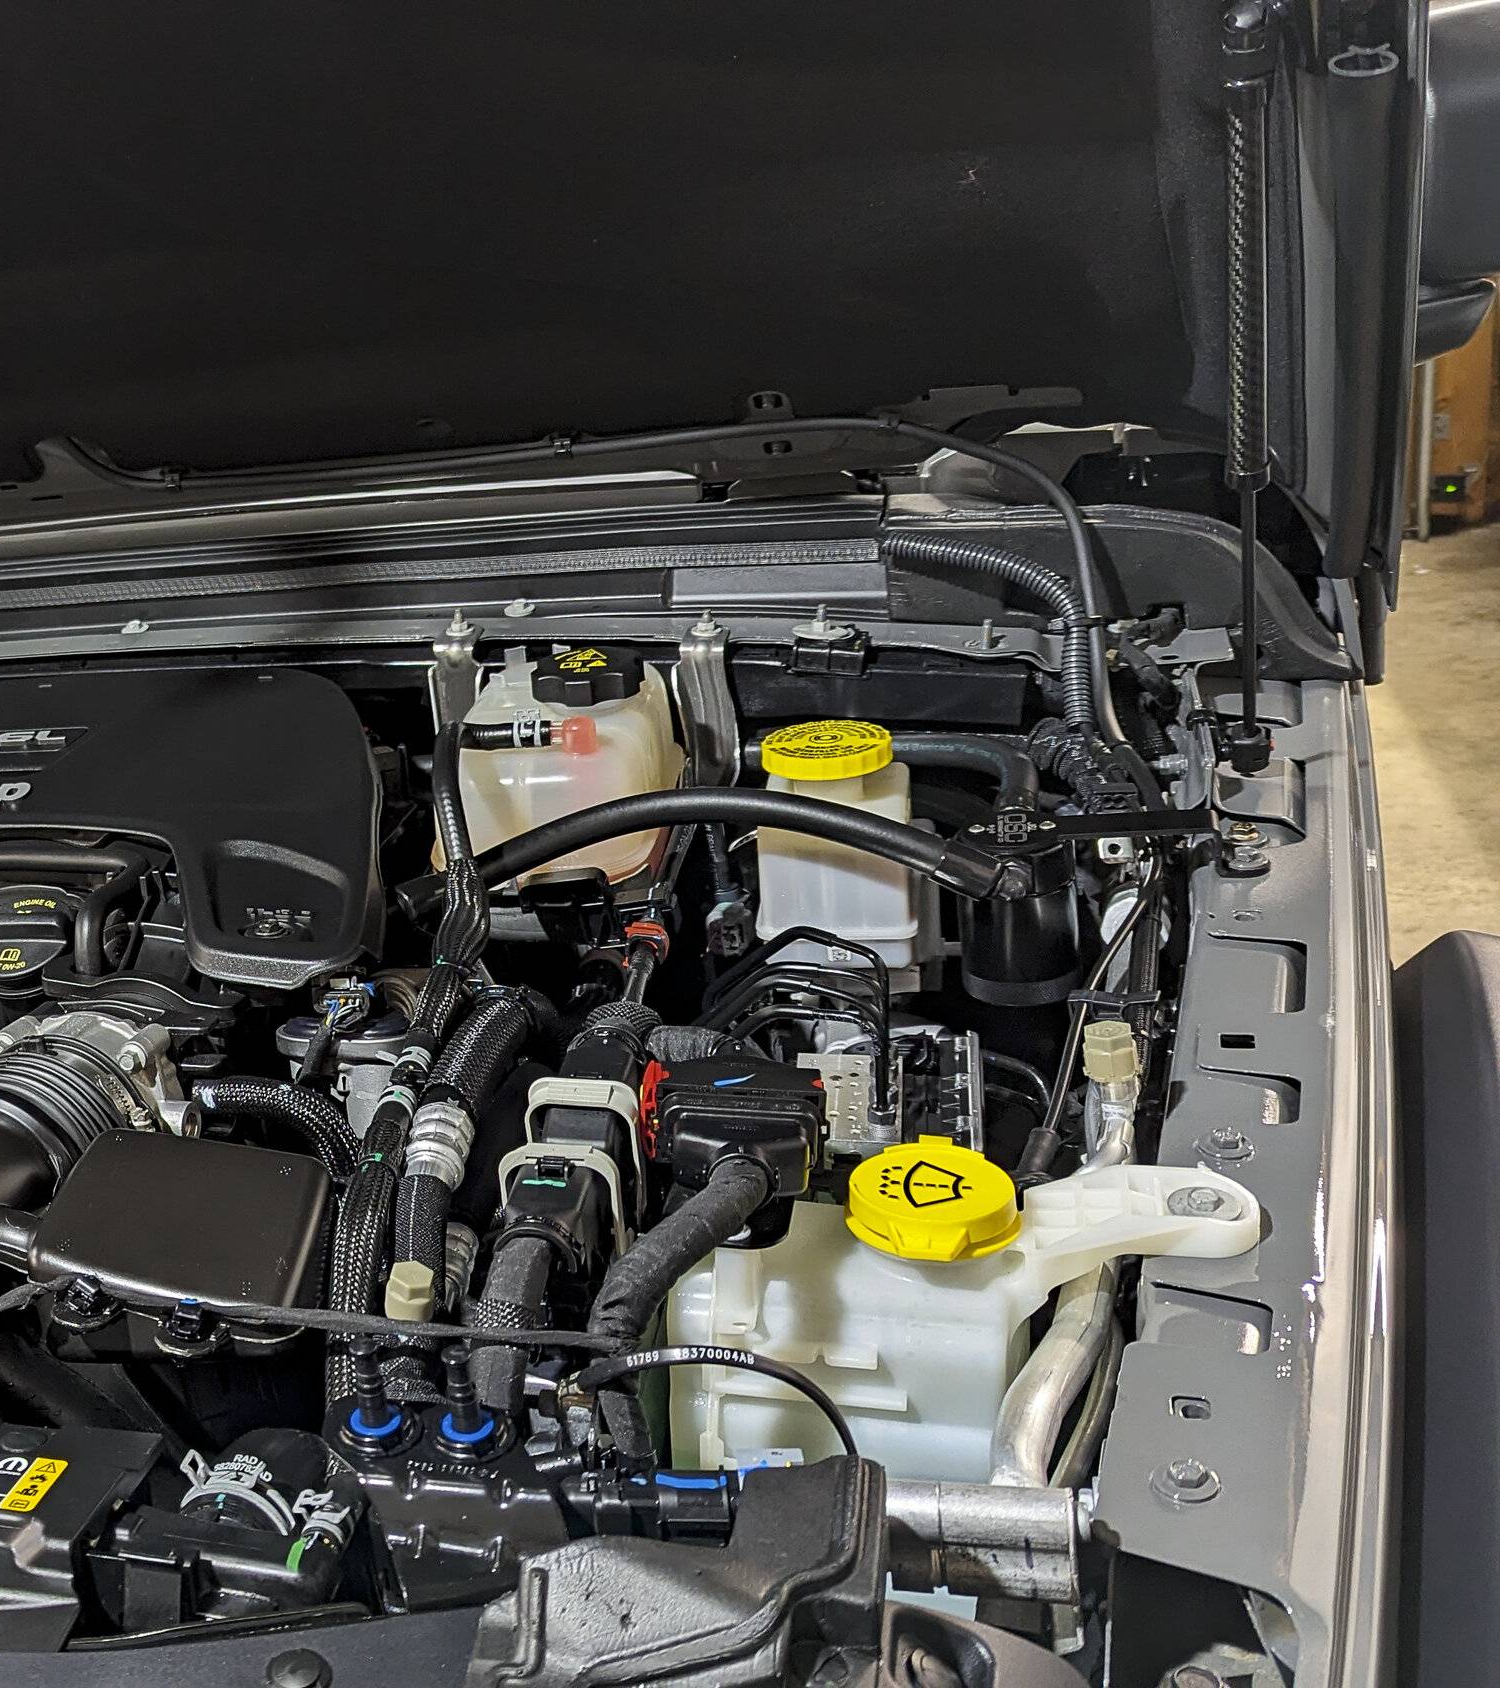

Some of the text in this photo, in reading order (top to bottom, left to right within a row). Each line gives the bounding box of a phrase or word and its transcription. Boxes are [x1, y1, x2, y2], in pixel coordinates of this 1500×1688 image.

[13, 900, 56, 909] ENGINE OIL
[233, 1454, 259, 1465] RAD
